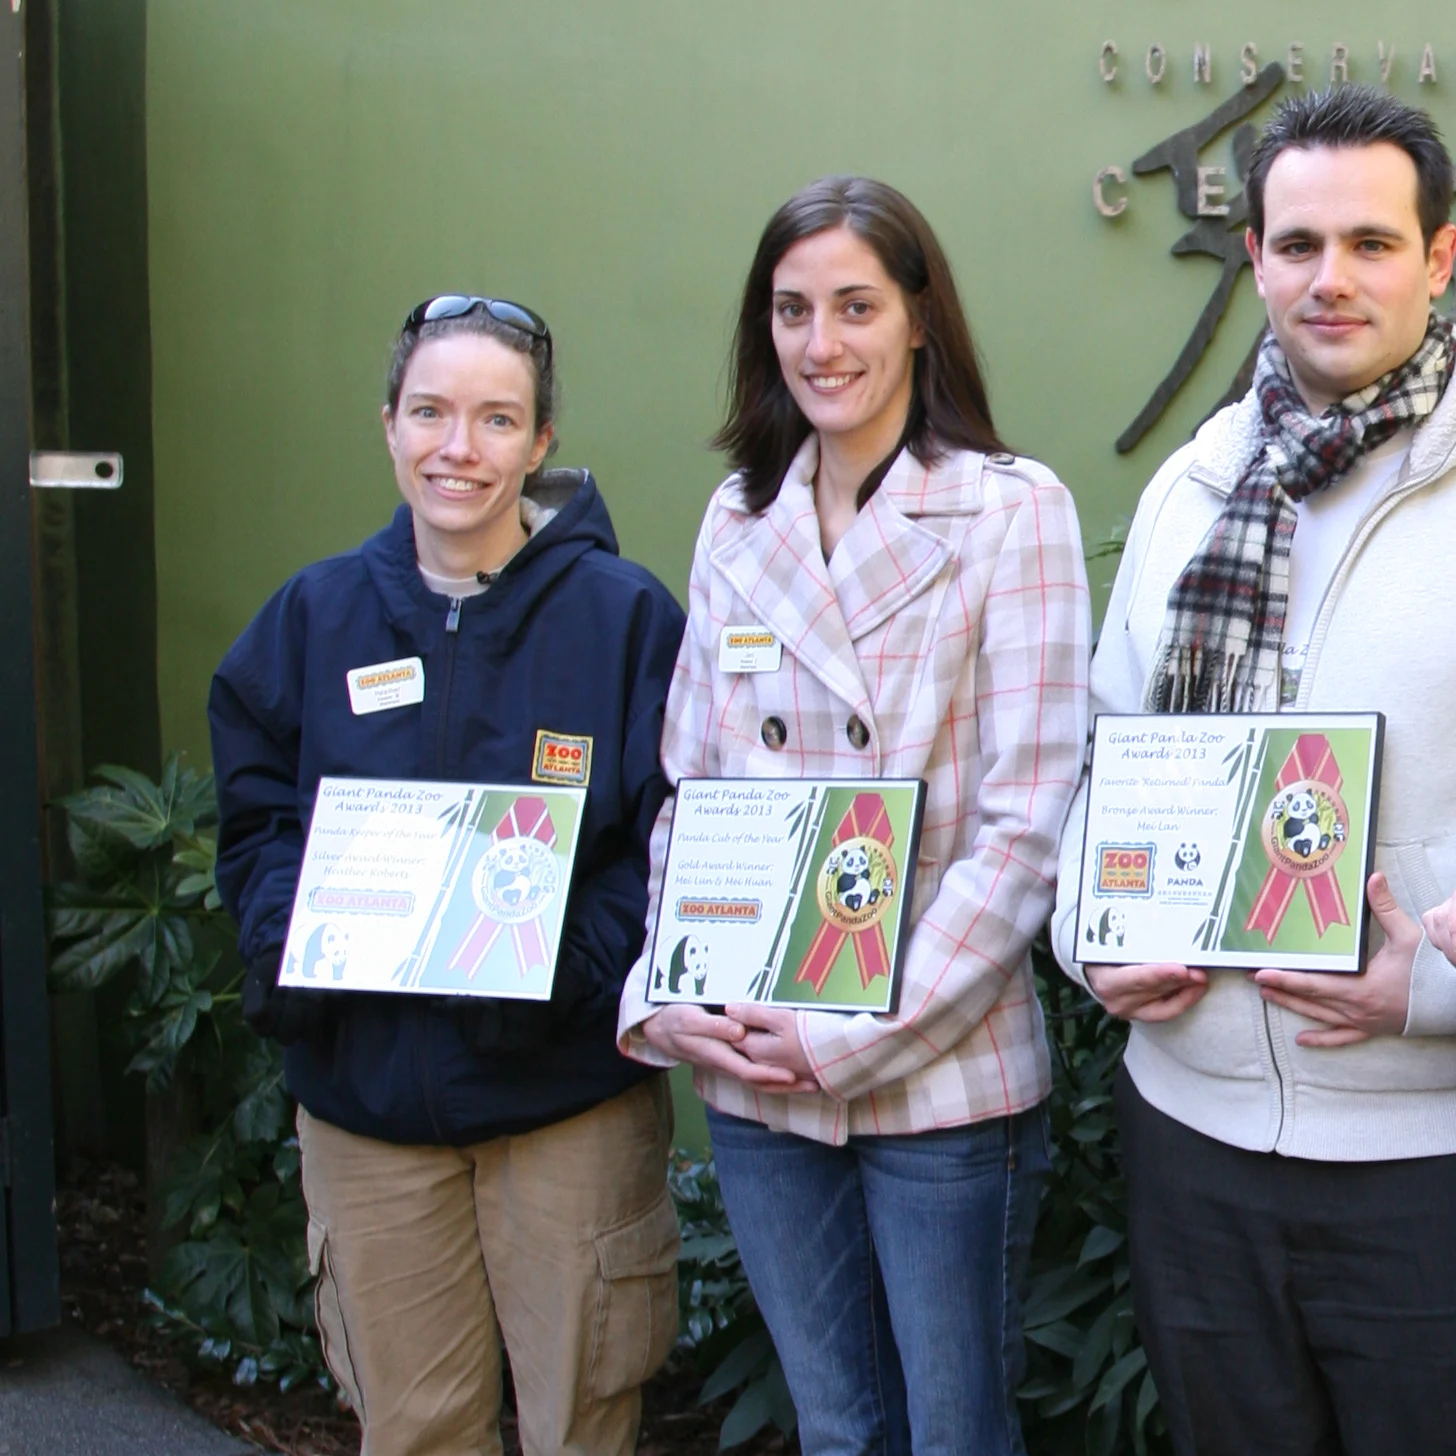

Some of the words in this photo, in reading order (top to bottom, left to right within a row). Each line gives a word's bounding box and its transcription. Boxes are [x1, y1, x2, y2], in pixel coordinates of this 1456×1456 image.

[1108, 731, 1148, 744] Giant
[1150, 731, 1198, 744] Panda
[1199, 732, 1225, 744] Zoo
[547, 743, 582, 760] ZOO
[1121, 747, 1171, 759] Awards
[1174, 748, 1207, 760] 2013
[543, 763, 581, 774] ATLANTA
[324, 785, 364, 798] Giant
[366, 787, 415, 800] Panda
[416, 789, 443, 801] Zoo
[684, 788, 721, 801] Giant
[722, 788, 765, 801] Panda
[766, 789, 791, 801] Zoo
[335, 800, 386, 813] Awards
[389, 802, 423, 814] 2013
[694, 803, 742, 816] Awards
[742, 804, 772, 816] 2013
[1101, 805, 1137, 817] Bronze
[1140, 805, 1175, 815] Award
[1137, 821, 1156, 831] Mei
[1158, 821, 1180, 831] Lan
[732, 832, 746, 845] of
[746, 833, 760, 843] the
[762, 833, 785, 843] Year
[678, 859, 700, 870] Gold
[700, 860, 735, 871] Award
[1104, 853, 1148, 869] ZOO
[1101, 879, 1146, 889] ATLANTA
[1167, 877, 1203, 887] PANDA
[316, 894, 343, 905] ZOO
[347, 896, 408, 909] ATLANTA
[682, 904, 704, 914] ZOO
[706, 905, 756, 916] ATLANTA
